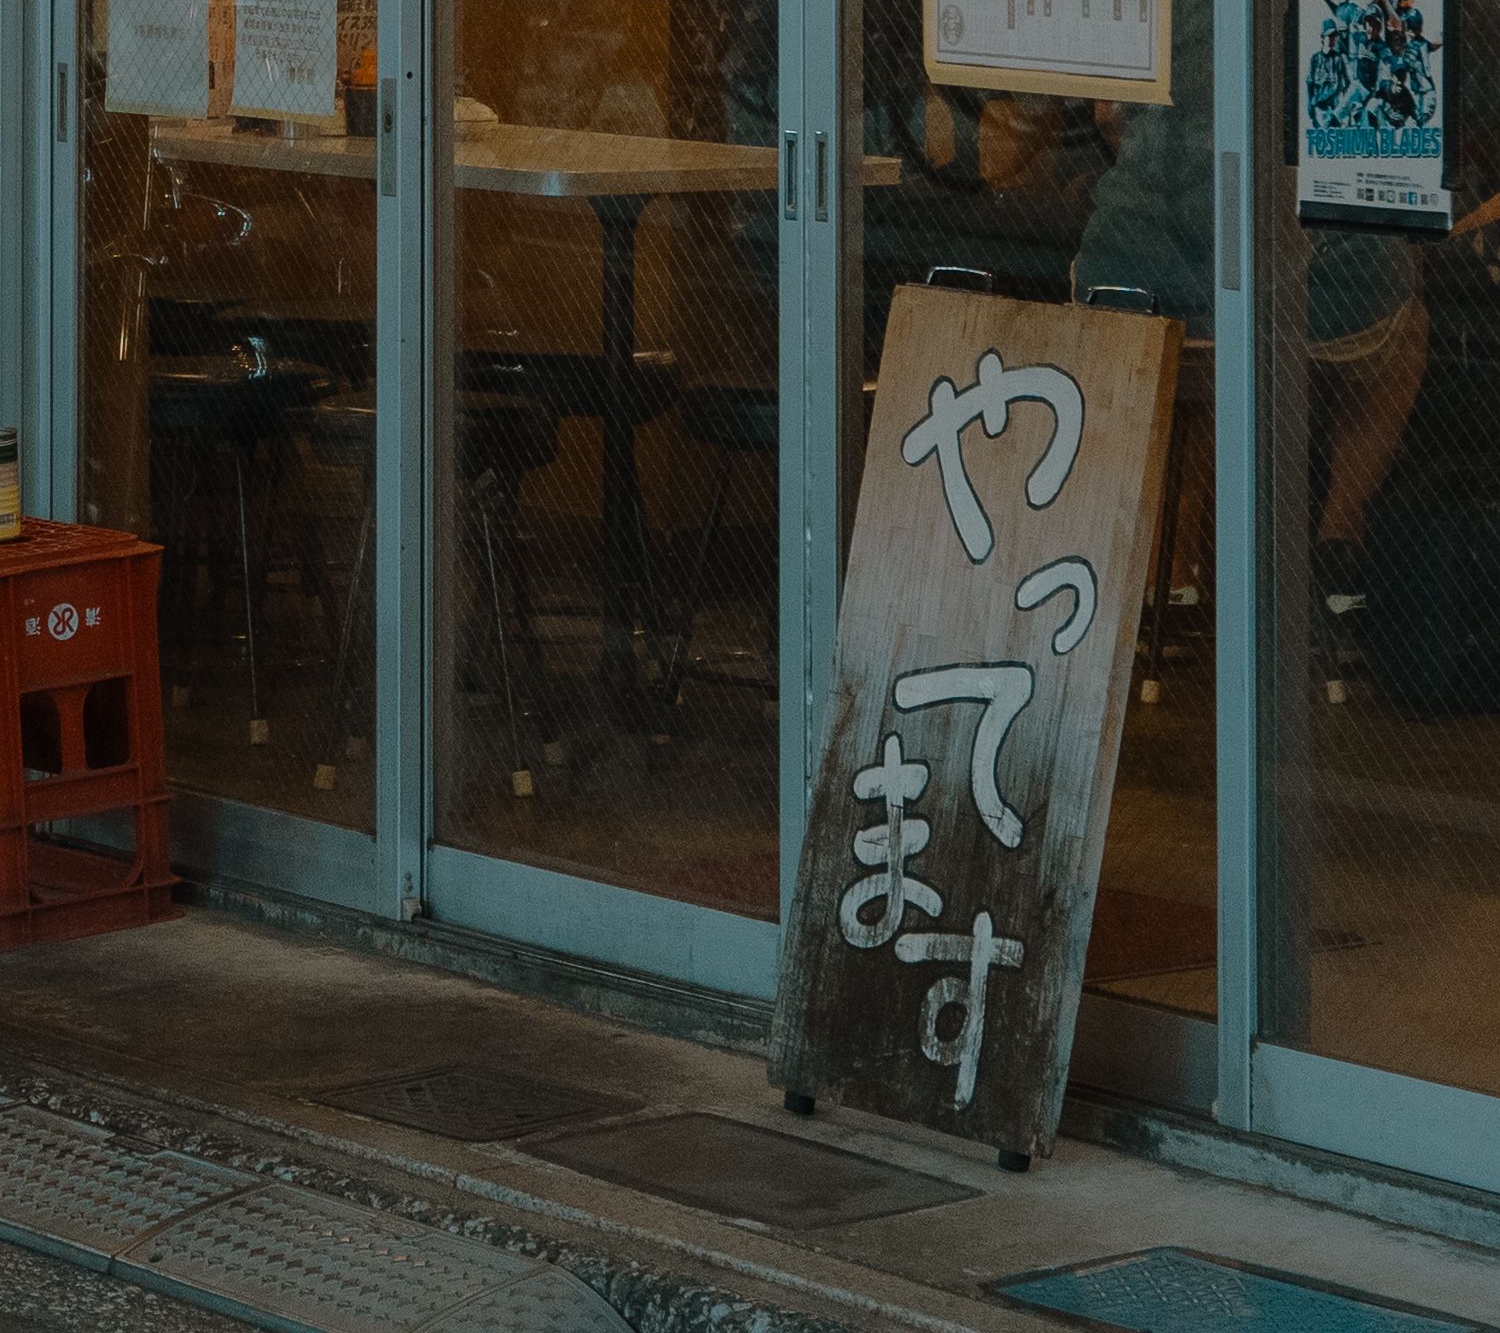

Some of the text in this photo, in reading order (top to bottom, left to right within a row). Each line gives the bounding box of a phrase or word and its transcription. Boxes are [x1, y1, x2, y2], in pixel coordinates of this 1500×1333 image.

[1305, 126, 1442, 159] TOSHIMA BLADES
[839, 347, 1098, 1113] やってます
